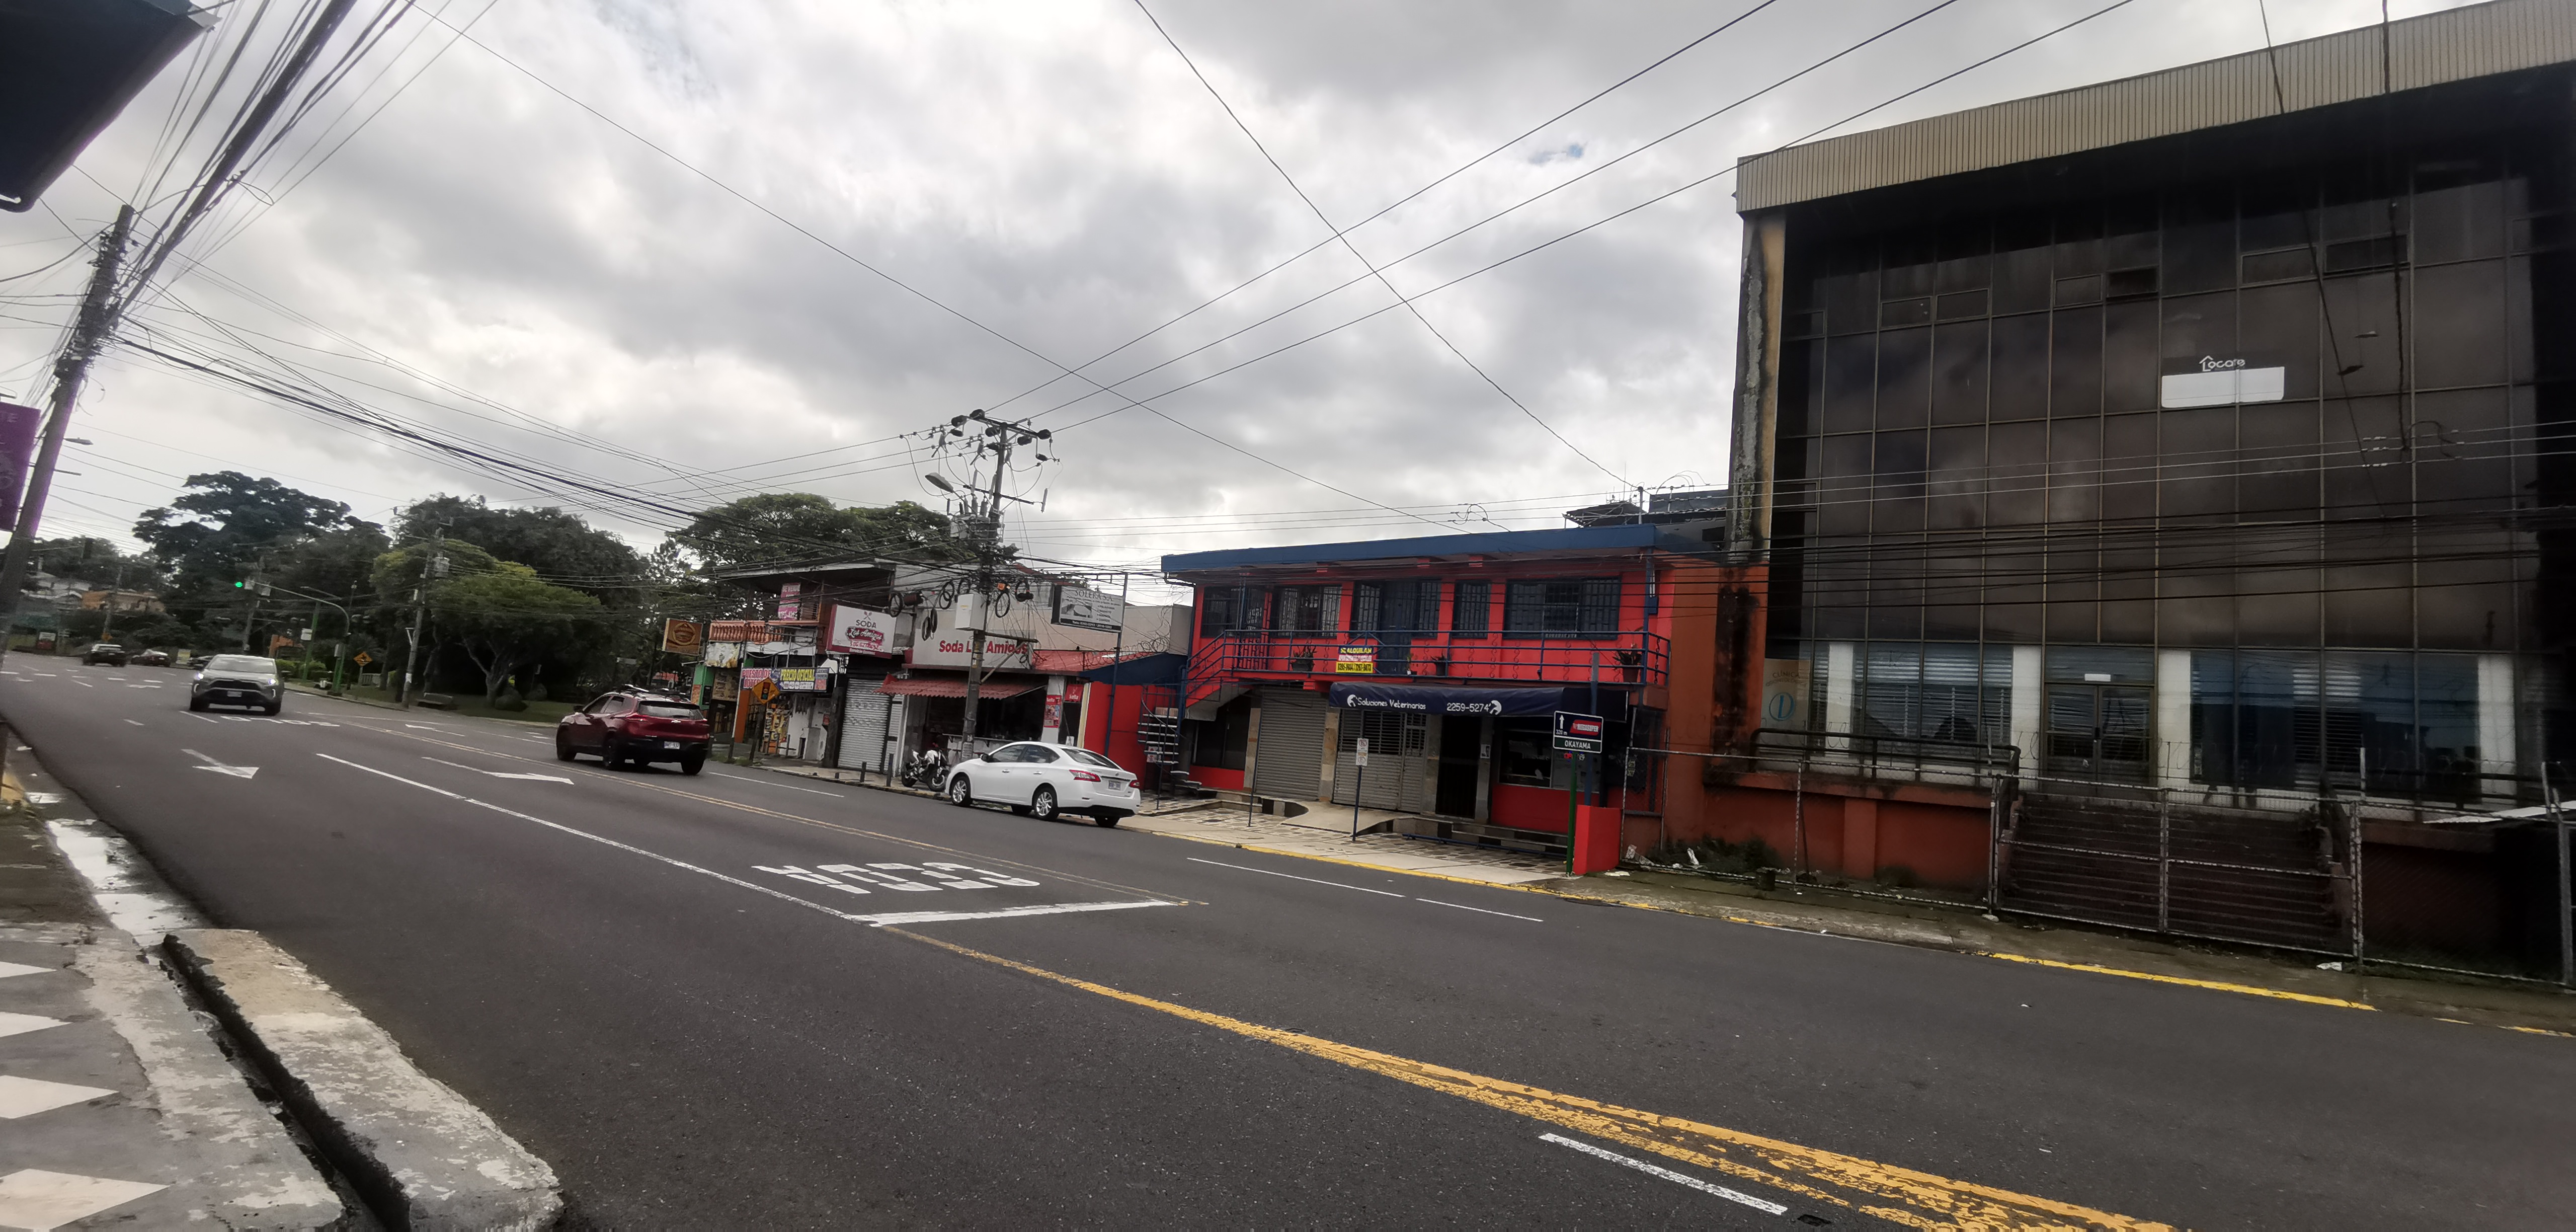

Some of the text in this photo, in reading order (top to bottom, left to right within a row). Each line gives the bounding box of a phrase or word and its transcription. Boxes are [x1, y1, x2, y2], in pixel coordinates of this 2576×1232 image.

[2201, 358, 2245, 371] Locare
[856, 620, 876, 629] SODA
[848, 628, 882, 641] Los Amigos
[939, 640, 964, 653] Soda
[742, 668, 763, 678] PUESTO
[780, 669, 796, 681] PRECIO
[797, 669, 815, 681] OFICIAL
[1358, 697, 1489, 712] Soluciones Veterinarias 2259-5274
[1564, 740, 1591, 749] OKAYAMA
